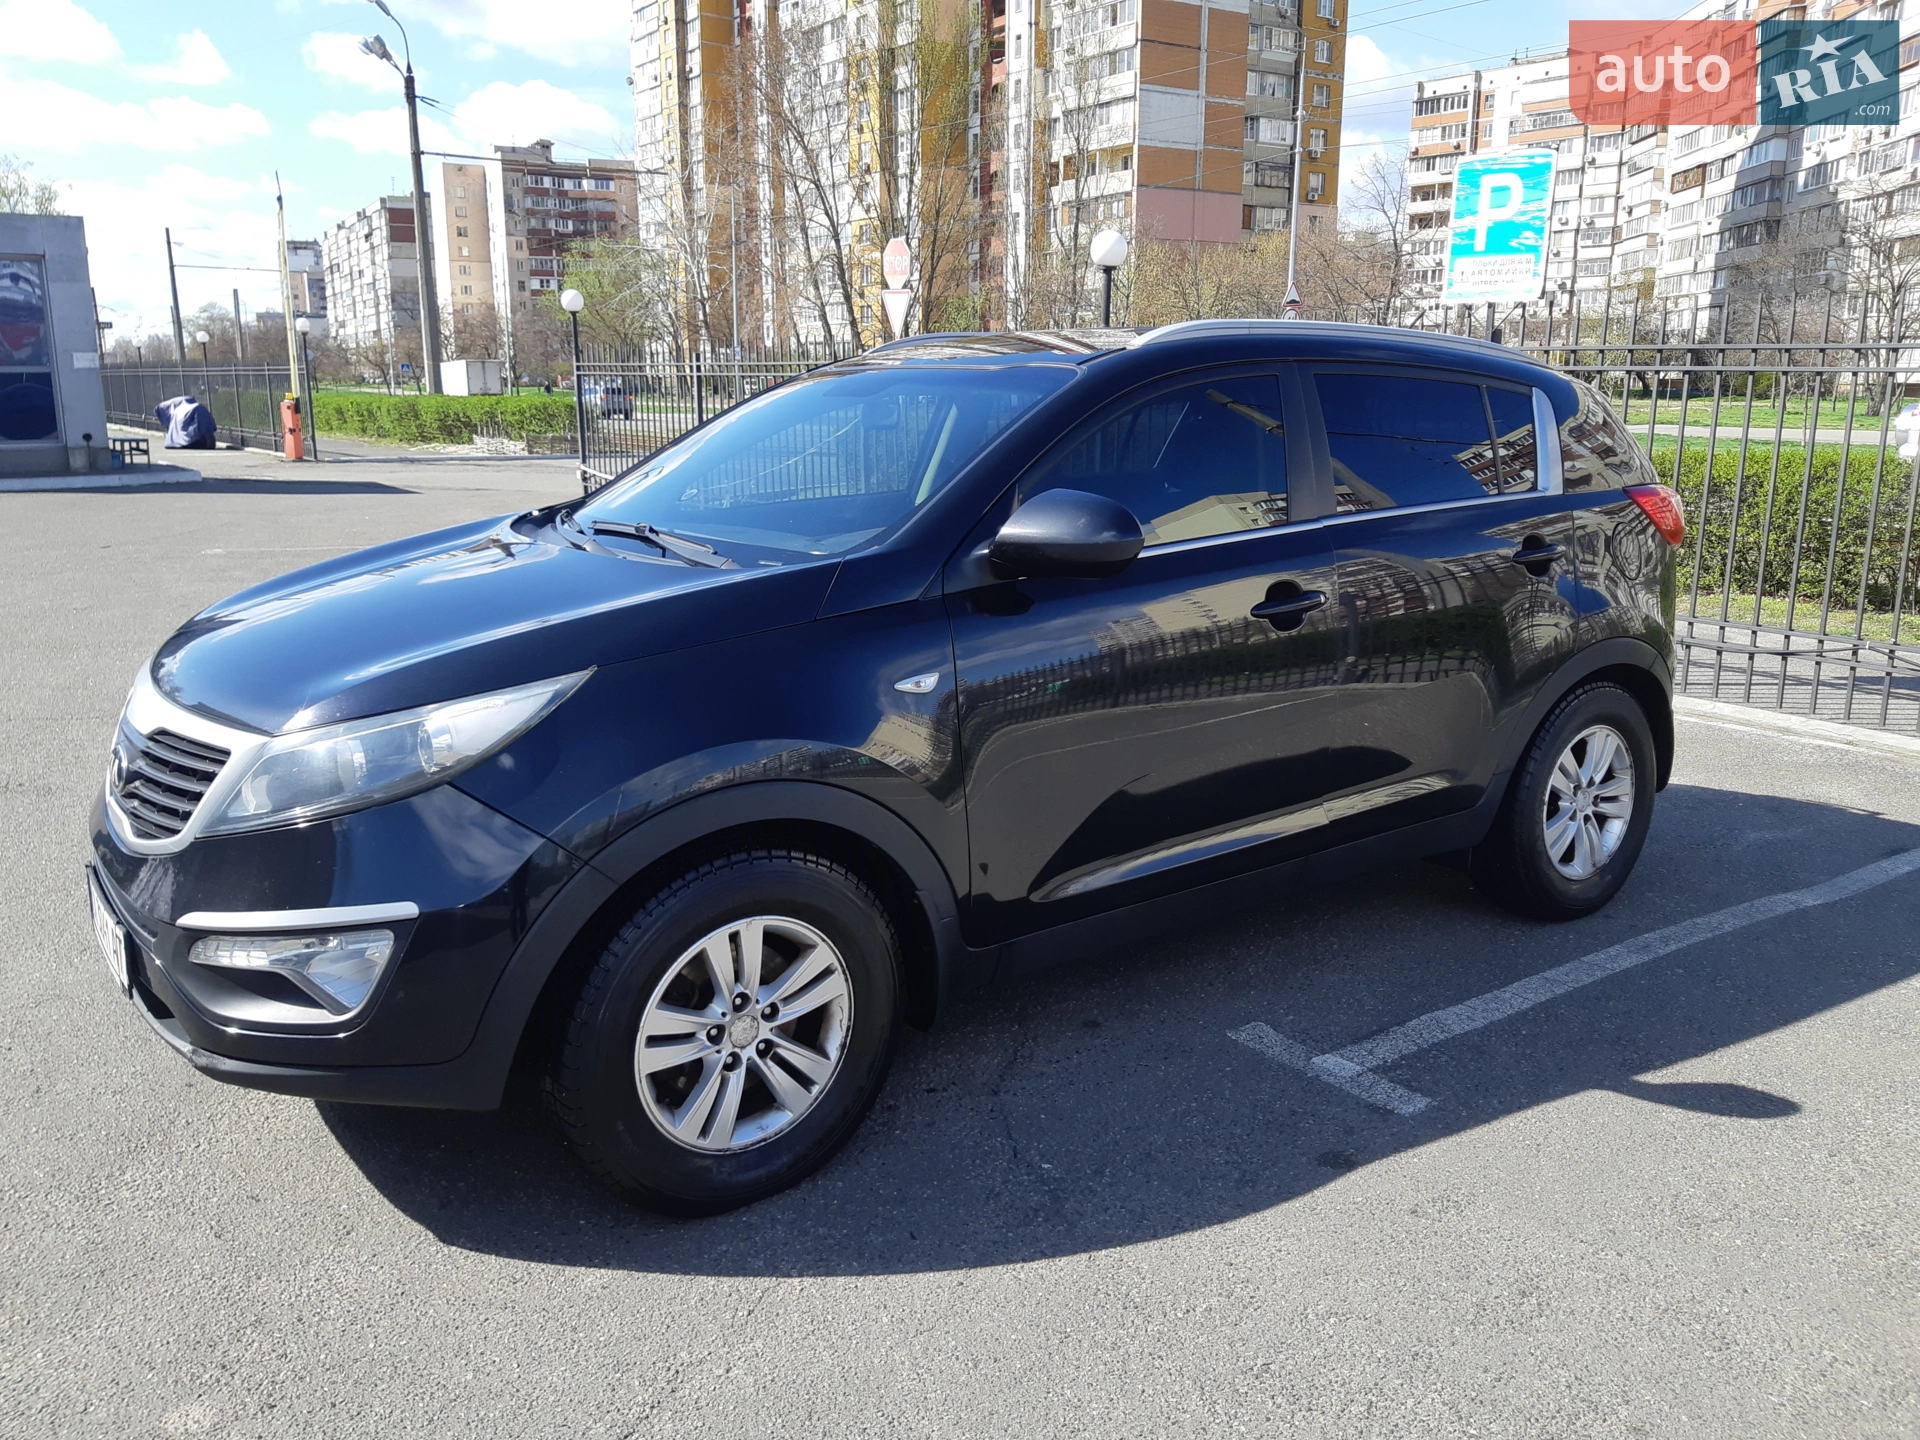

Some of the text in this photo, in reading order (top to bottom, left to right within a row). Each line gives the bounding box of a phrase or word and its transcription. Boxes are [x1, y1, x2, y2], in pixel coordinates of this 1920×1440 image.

[1473, 172, 1524, 252] P
[884, 255, 909, 272] STOP
[1472, 259, 1498, 267] ІЛЬКИ
